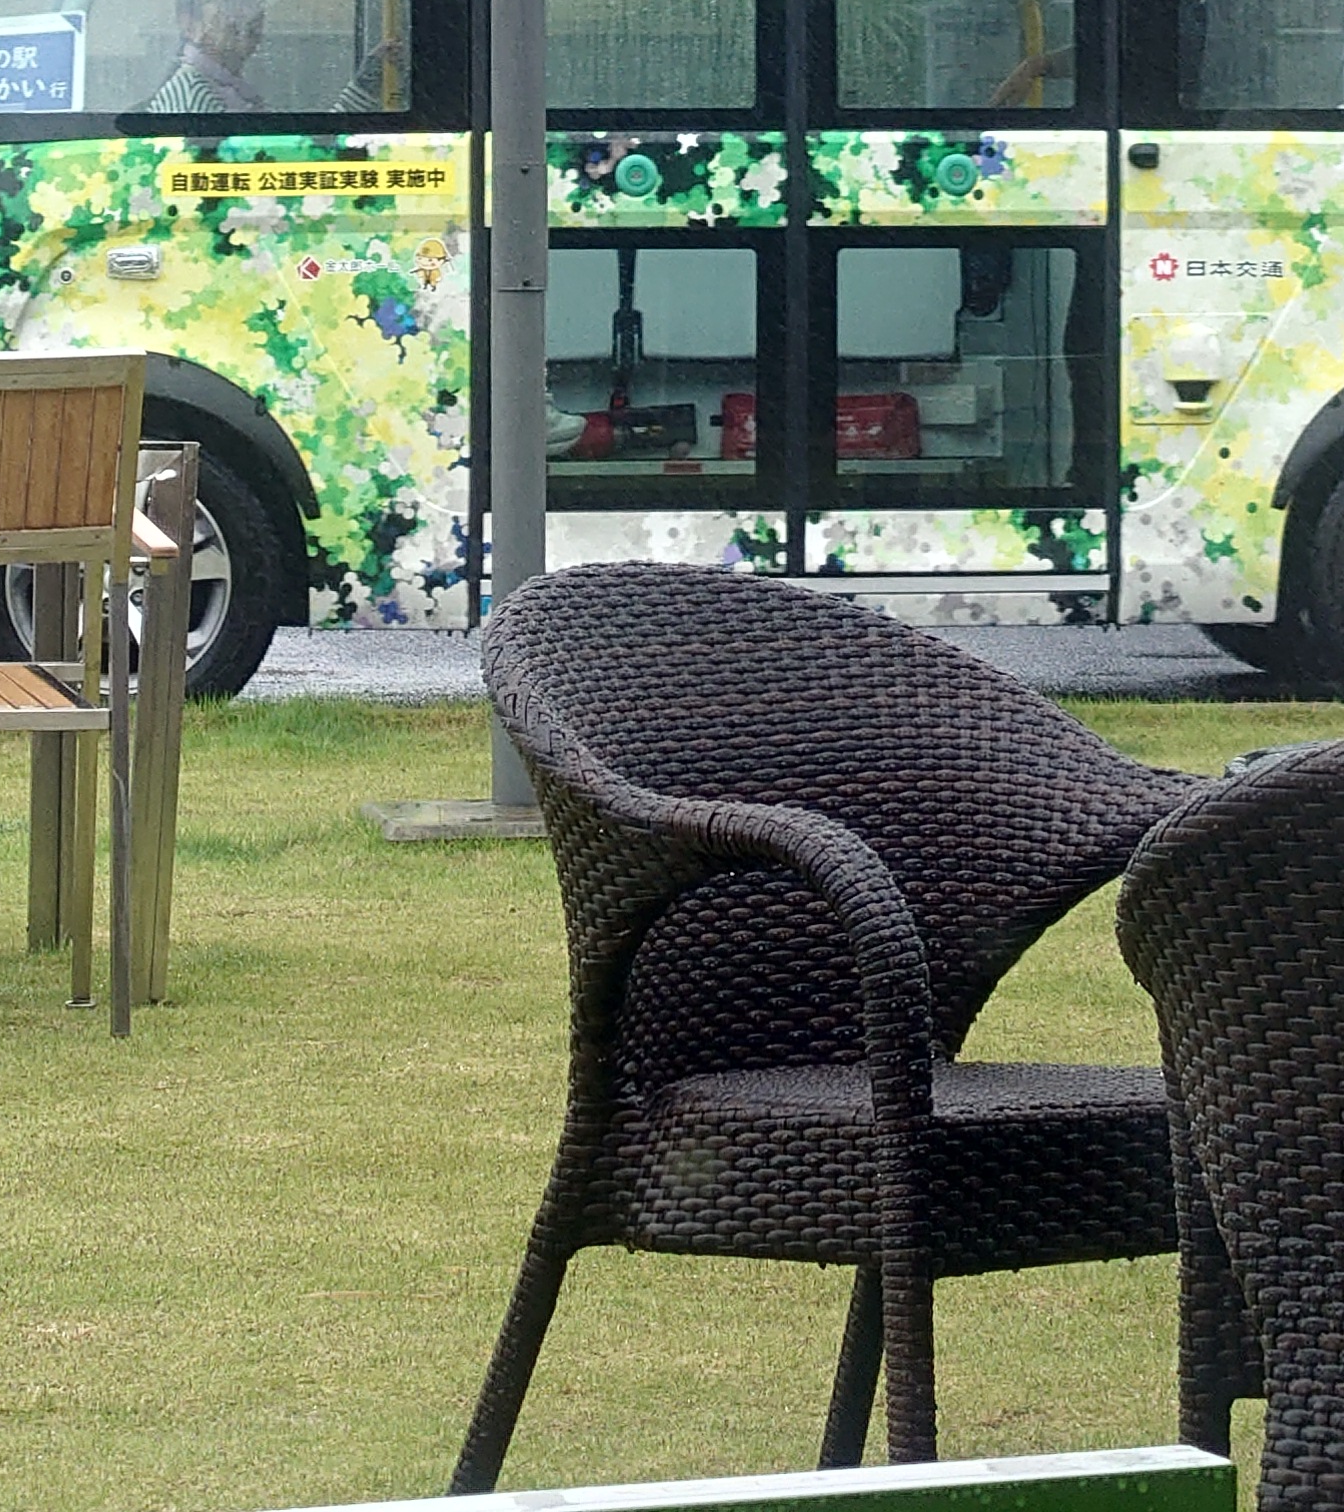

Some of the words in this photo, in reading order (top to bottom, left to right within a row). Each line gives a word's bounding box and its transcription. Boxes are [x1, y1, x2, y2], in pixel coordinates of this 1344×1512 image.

[171, 172, 251, 192] 自動運転
[258, 169, 379, 190] 公道実証実験
[386, 168, 446, 188] 実施中
[1186, 260, 1283, 278] 日本交通
